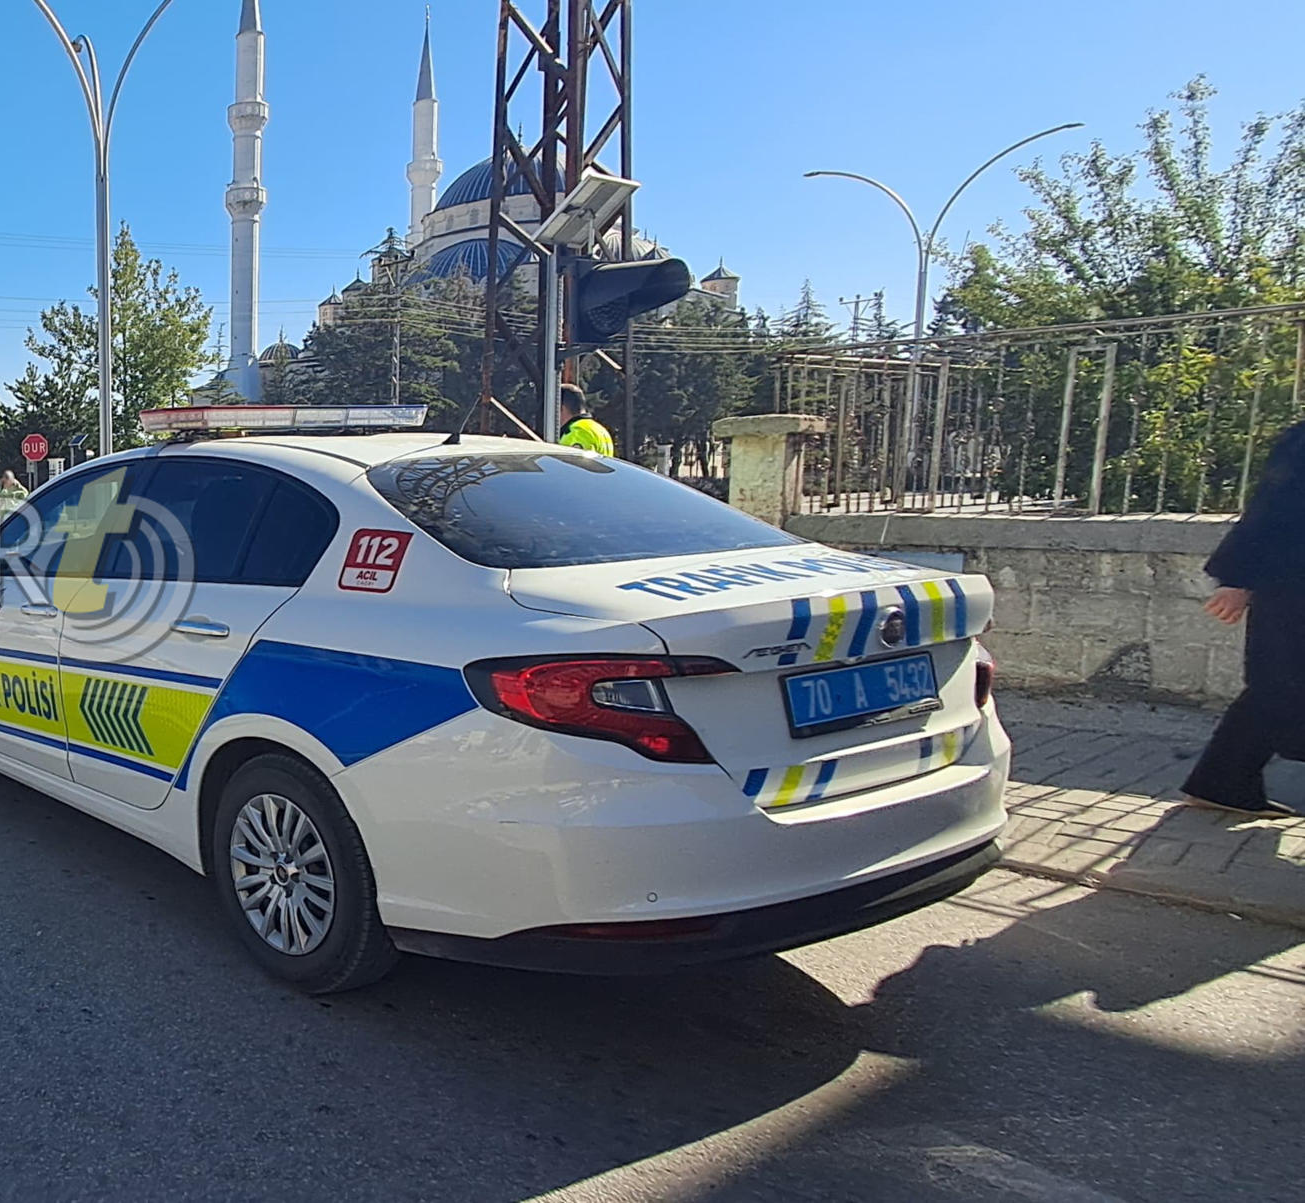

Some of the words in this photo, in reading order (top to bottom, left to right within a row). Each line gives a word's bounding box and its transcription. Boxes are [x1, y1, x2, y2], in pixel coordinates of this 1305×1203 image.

[24, 443, 46, 453] DUR
[356, 536, 399, 566] 112
[615, 564, 816, 601] TRAFİK
[1, 671, 59, 721] POLİSİ
[801, 679, 833, 718] 70
[853, 672, 869, 709] A
[884, 661, 934, 701] 5432
